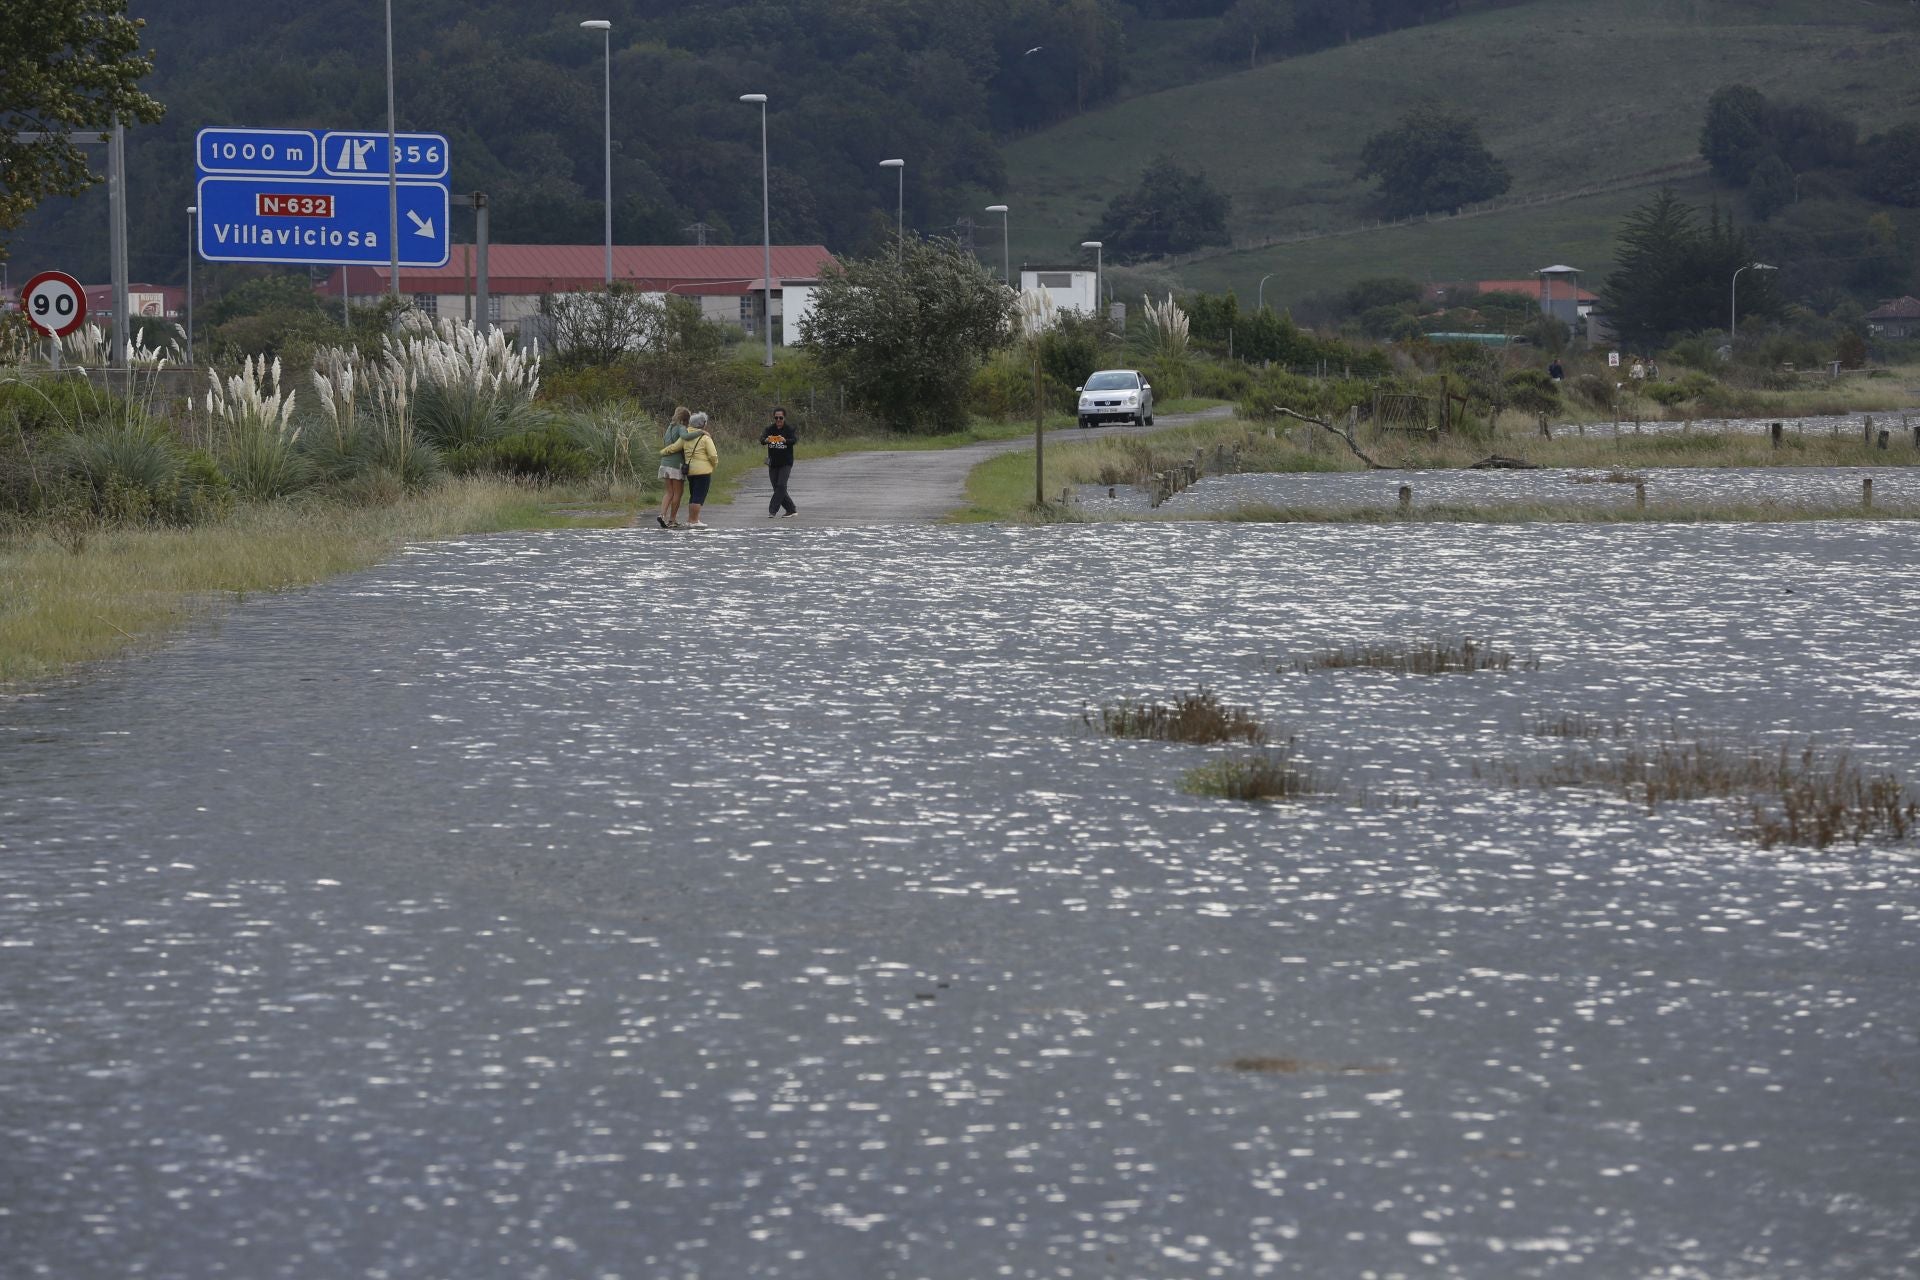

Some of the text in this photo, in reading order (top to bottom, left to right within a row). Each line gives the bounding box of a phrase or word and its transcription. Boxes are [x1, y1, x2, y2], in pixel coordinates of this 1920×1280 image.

[212, 142, 303, 161] 1000 m
[263, 197, 327, 214] N-632
[213, 223, 377, 247] Villaviciosa
[33, 293, 74, 316] 90
